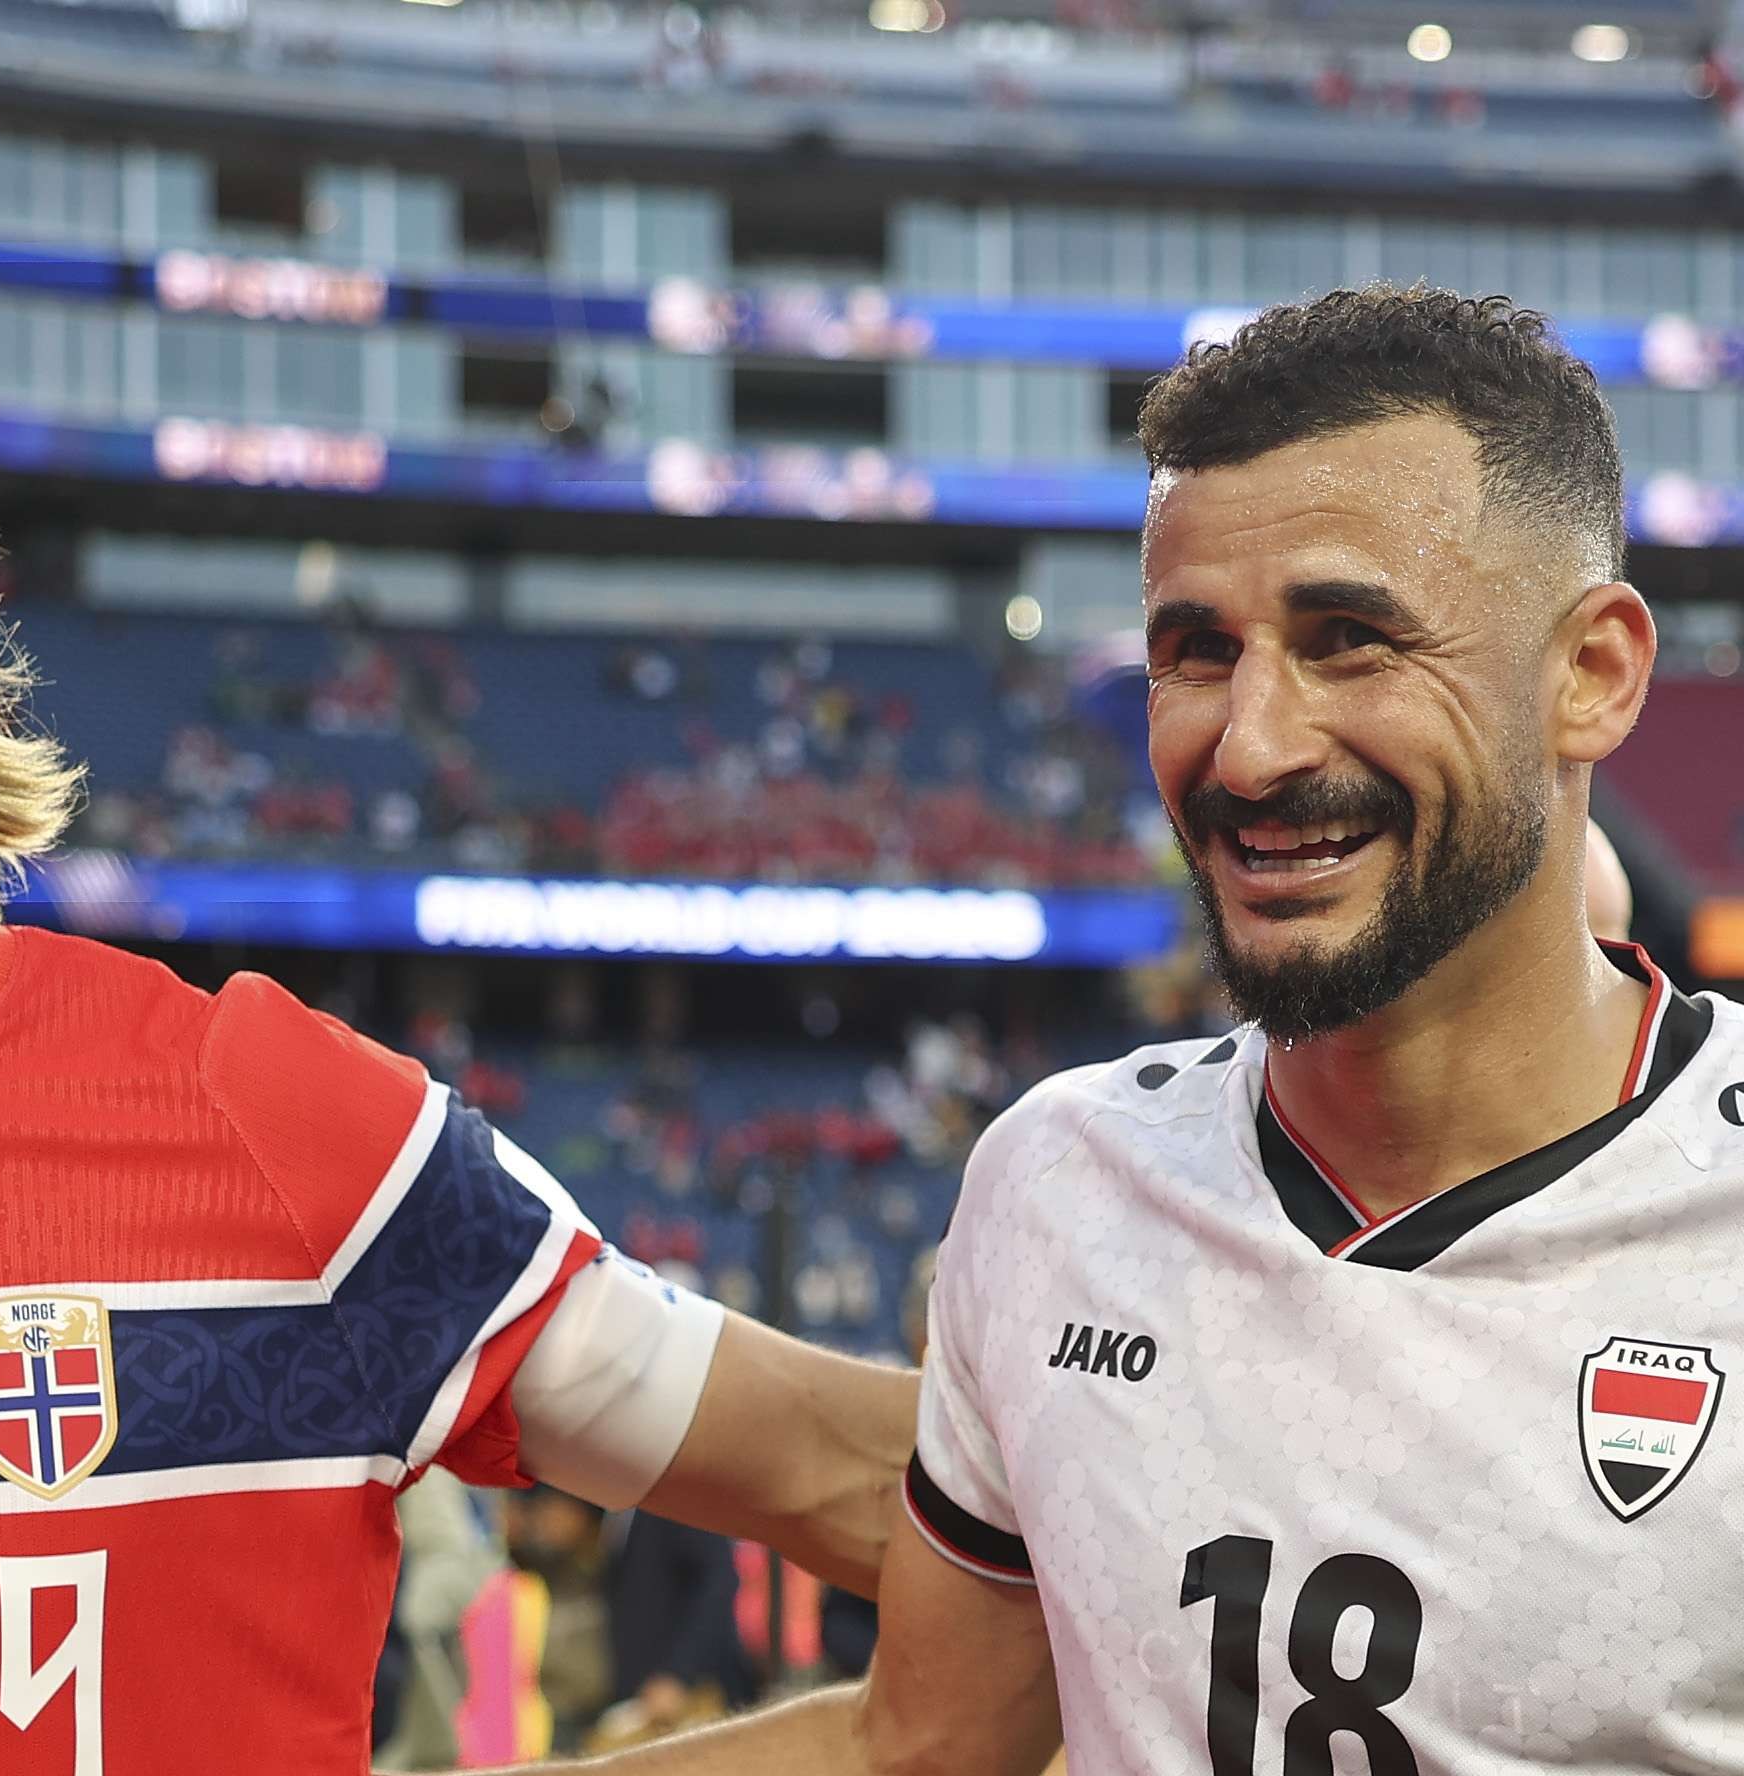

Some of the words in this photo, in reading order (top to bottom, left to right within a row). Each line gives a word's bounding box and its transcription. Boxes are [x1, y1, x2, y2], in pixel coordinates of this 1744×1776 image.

[12, 1303, 56, 1320] NORGE
[1048, 1323, 1157, 1382] JAKO
[1617, 1348, 1695, 1373] IRAQ
